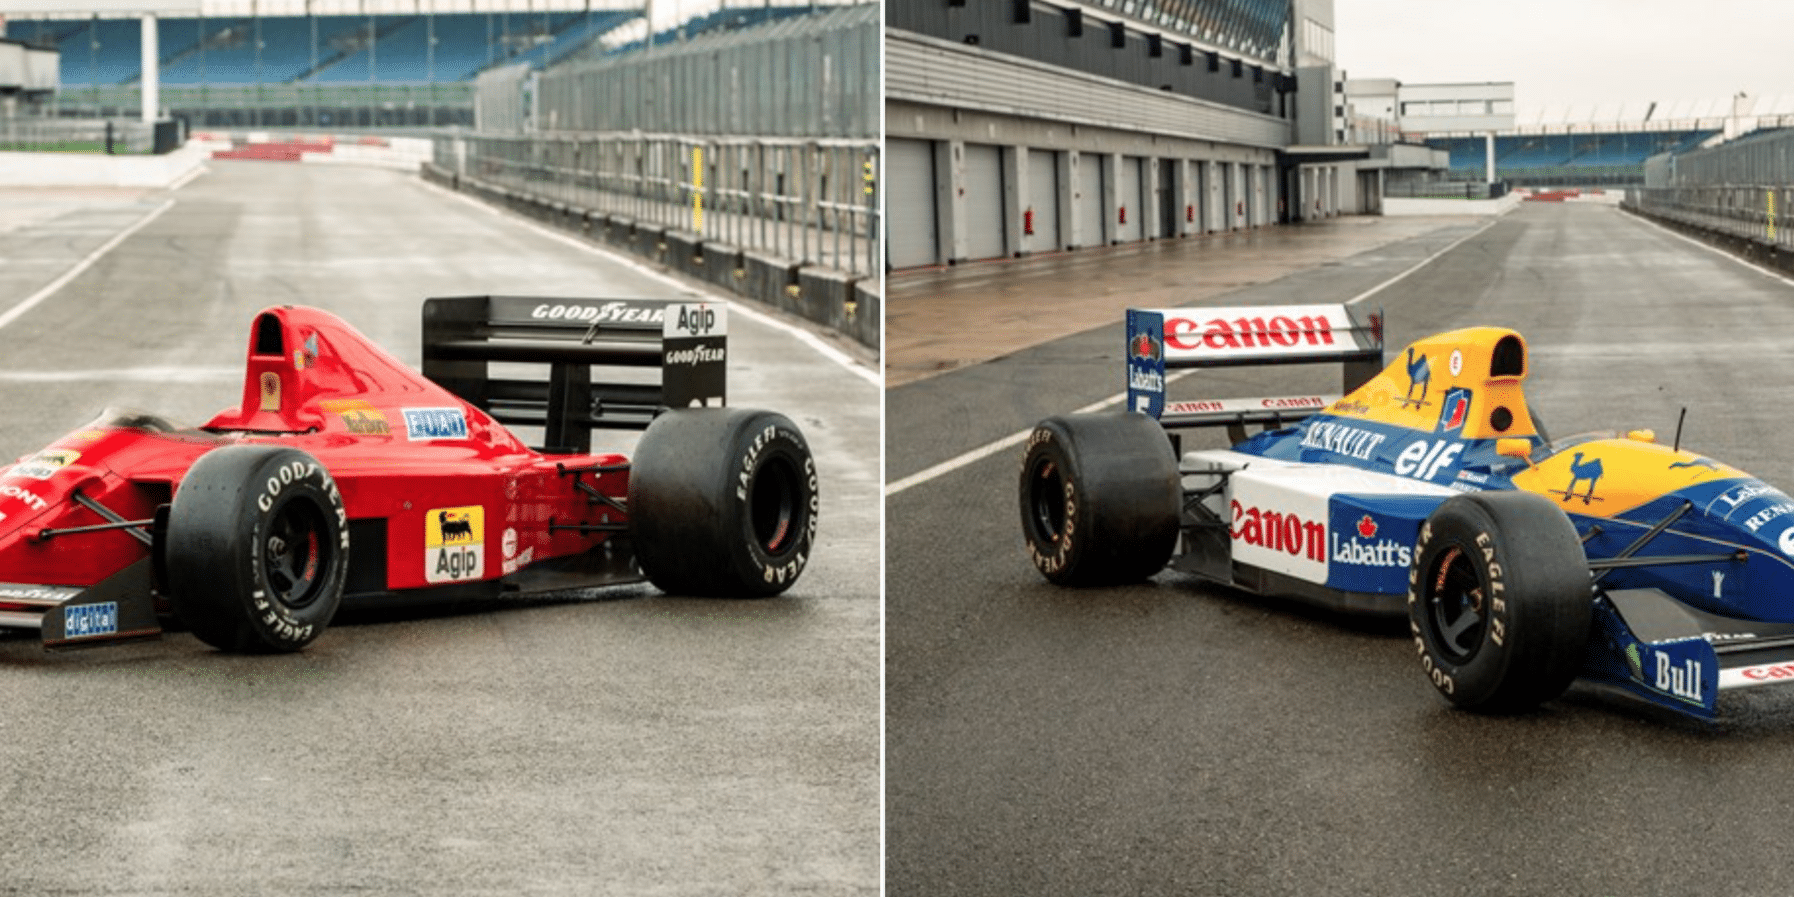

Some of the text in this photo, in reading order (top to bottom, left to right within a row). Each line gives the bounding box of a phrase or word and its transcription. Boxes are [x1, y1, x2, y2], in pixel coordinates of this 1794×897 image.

[532, 301, 664, 323] GOODYEAR
[677, 304, 715, 335] Agip
[1163, 315, 1335, 350] Canon
[666, 345, 724, 366] GOODYEAR
[409, 411, 467, 438] FIAT
[1300, 421, 1386, 460] RENAULT
[1394, 440, 1465, 480] elf
[1230, 499, 1325, 563] Canon
[436, 548, 477, 579] Agip
[1332, 532, 1411, 567] Labatt's
[1476, 532, 1505, 613] EAGLE
[1655, 650, 1702, 701] Bull
